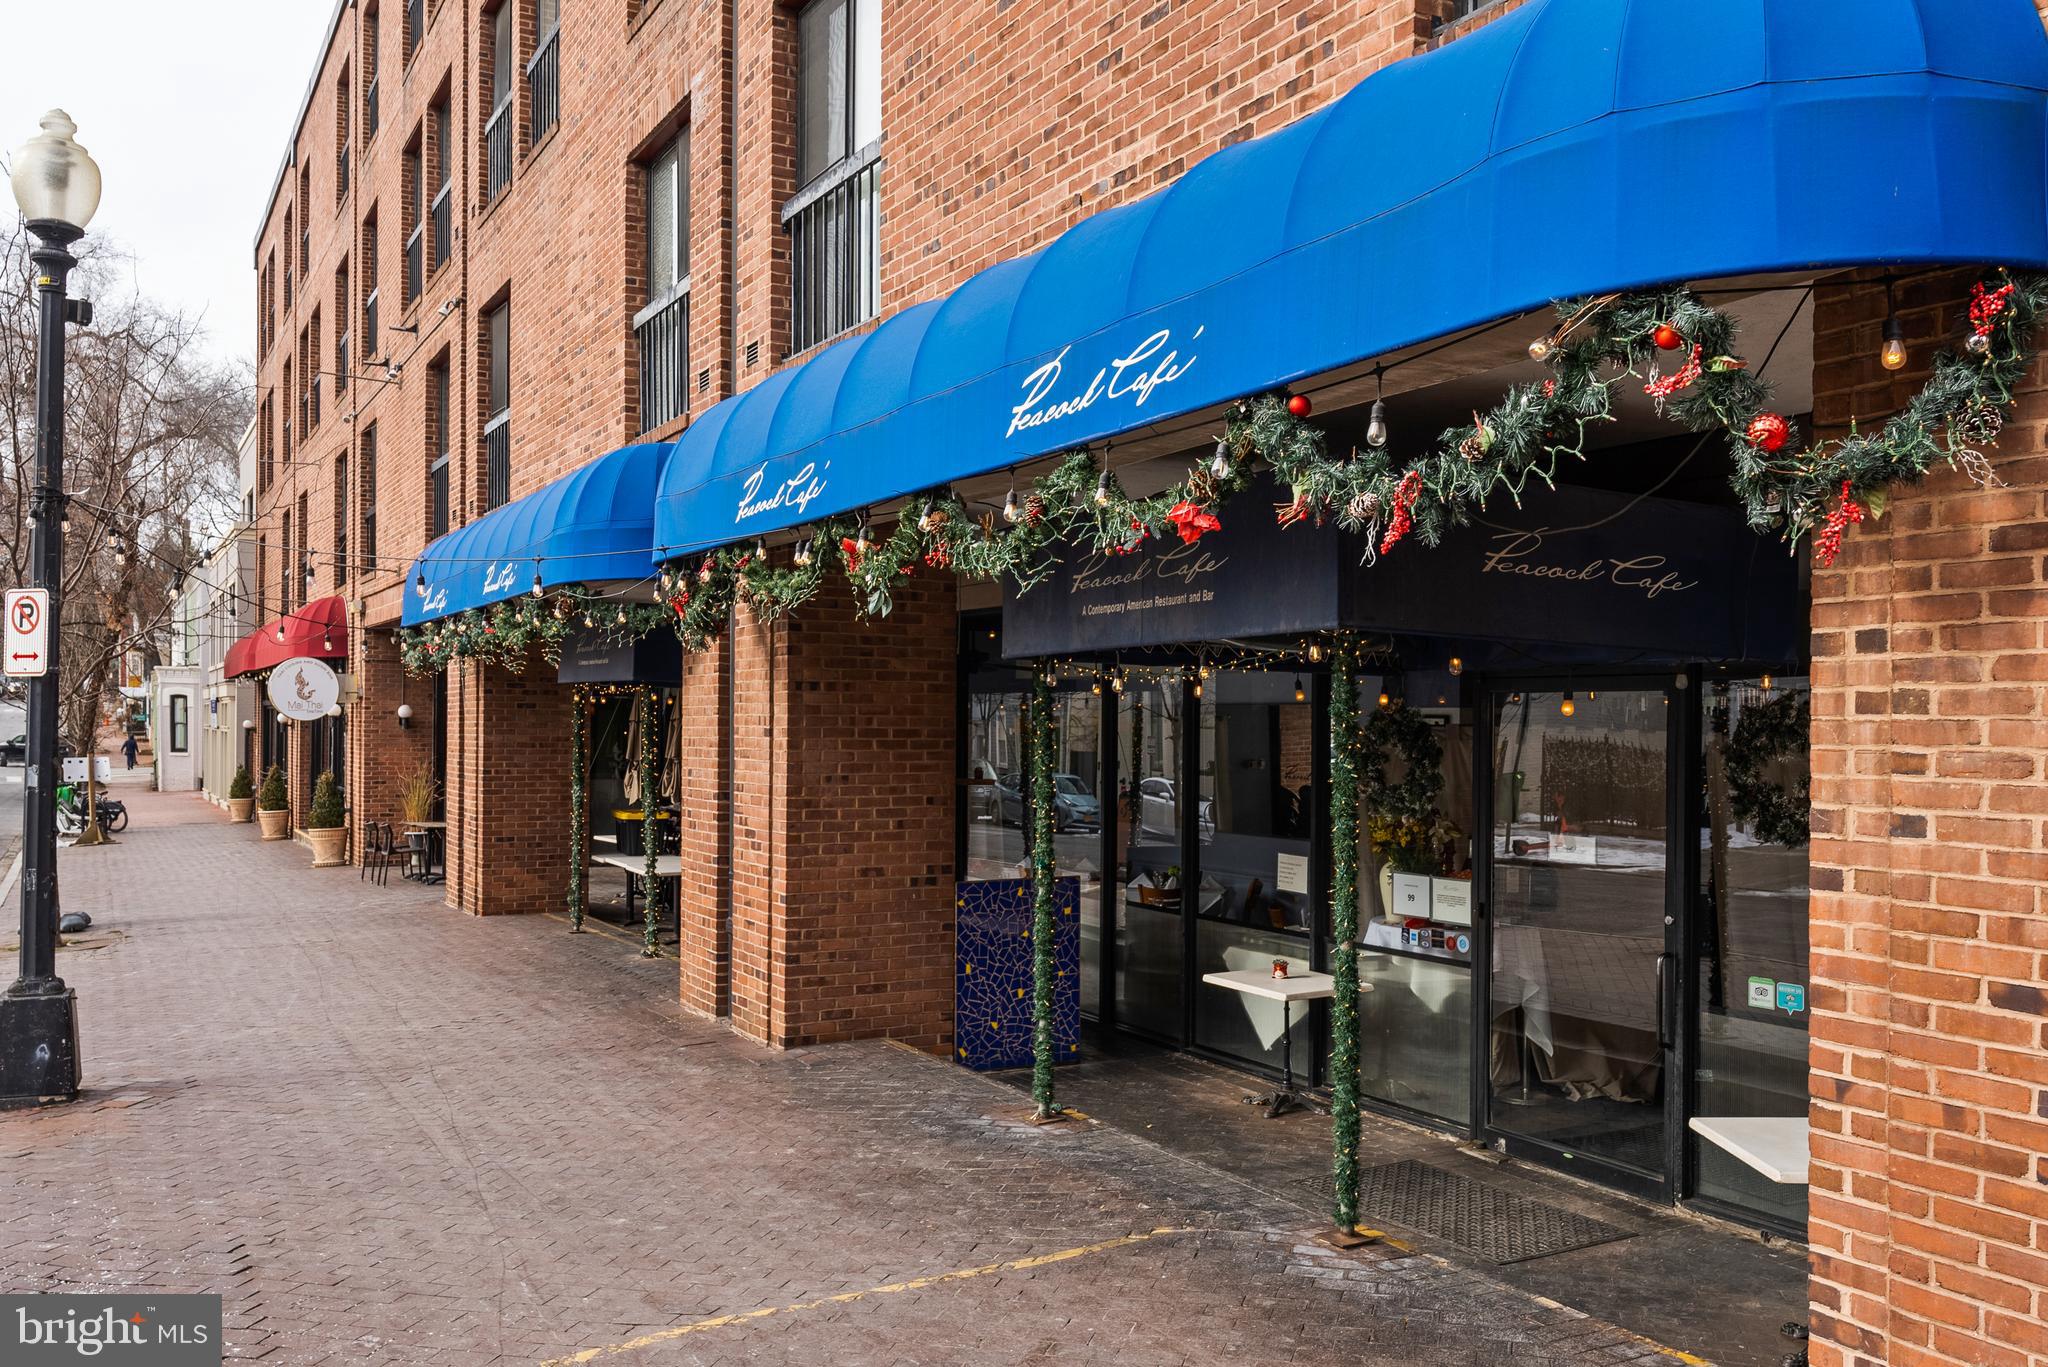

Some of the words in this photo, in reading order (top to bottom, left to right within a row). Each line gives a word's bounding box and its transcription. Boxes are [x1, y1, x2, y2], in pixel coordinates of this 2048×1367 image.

[1005, 345, 1107, 439] Peacock
[1107, 325, 1205, 407] Café
[735, 461, 785, 524] Peacock
[1070, 549, 1151, 594] Peacock
[1481, 527, 1606, 580] Peacock
[1609, 555, 1699, 599] Cafe
[1081, 604, 1087, 616] A
[1087, 601, 1126, 616] Contemporary
[1126, 599, 1153, 611] American
[1154, 593, 1188, 608] Restaurant
[1188, 590, 1201, 603] and
[1202, 589, 1215, 601] Bar
